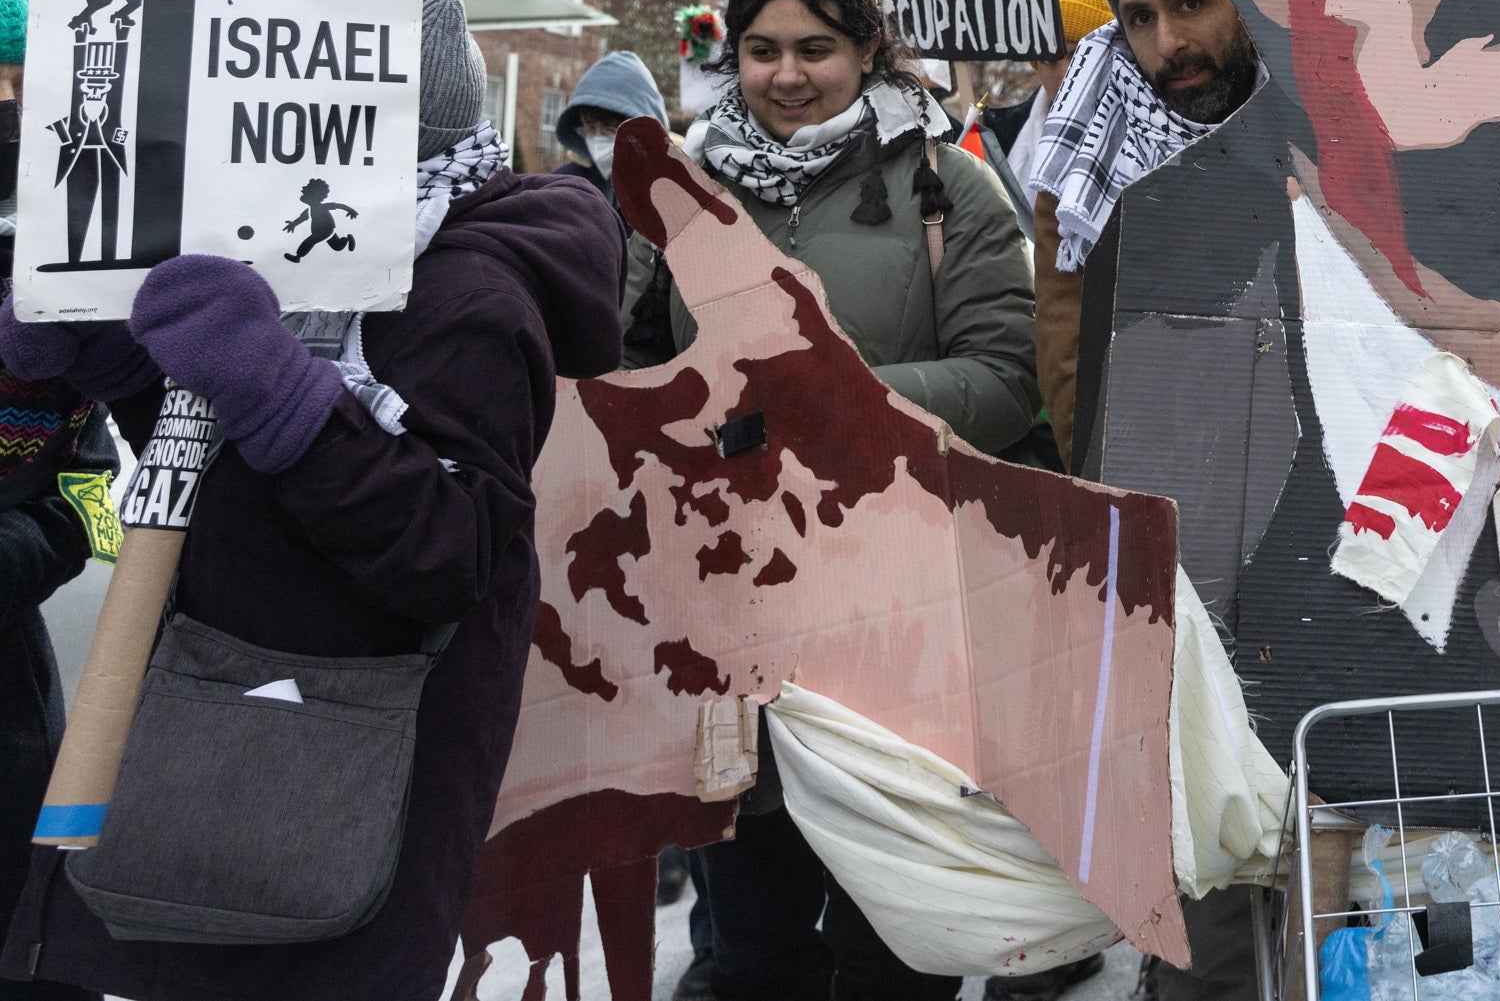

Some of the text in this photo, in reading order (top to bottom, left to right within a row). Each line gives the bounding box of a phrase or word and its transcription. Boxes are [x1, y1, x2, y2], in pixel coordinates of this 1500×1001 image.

[207, 16, 408, 83] ISRAEL
[230, 101, 377, 166] NOW!
[159, 417, 214, 440] COMMITT
[124, 467, 201, 527] GAZ
